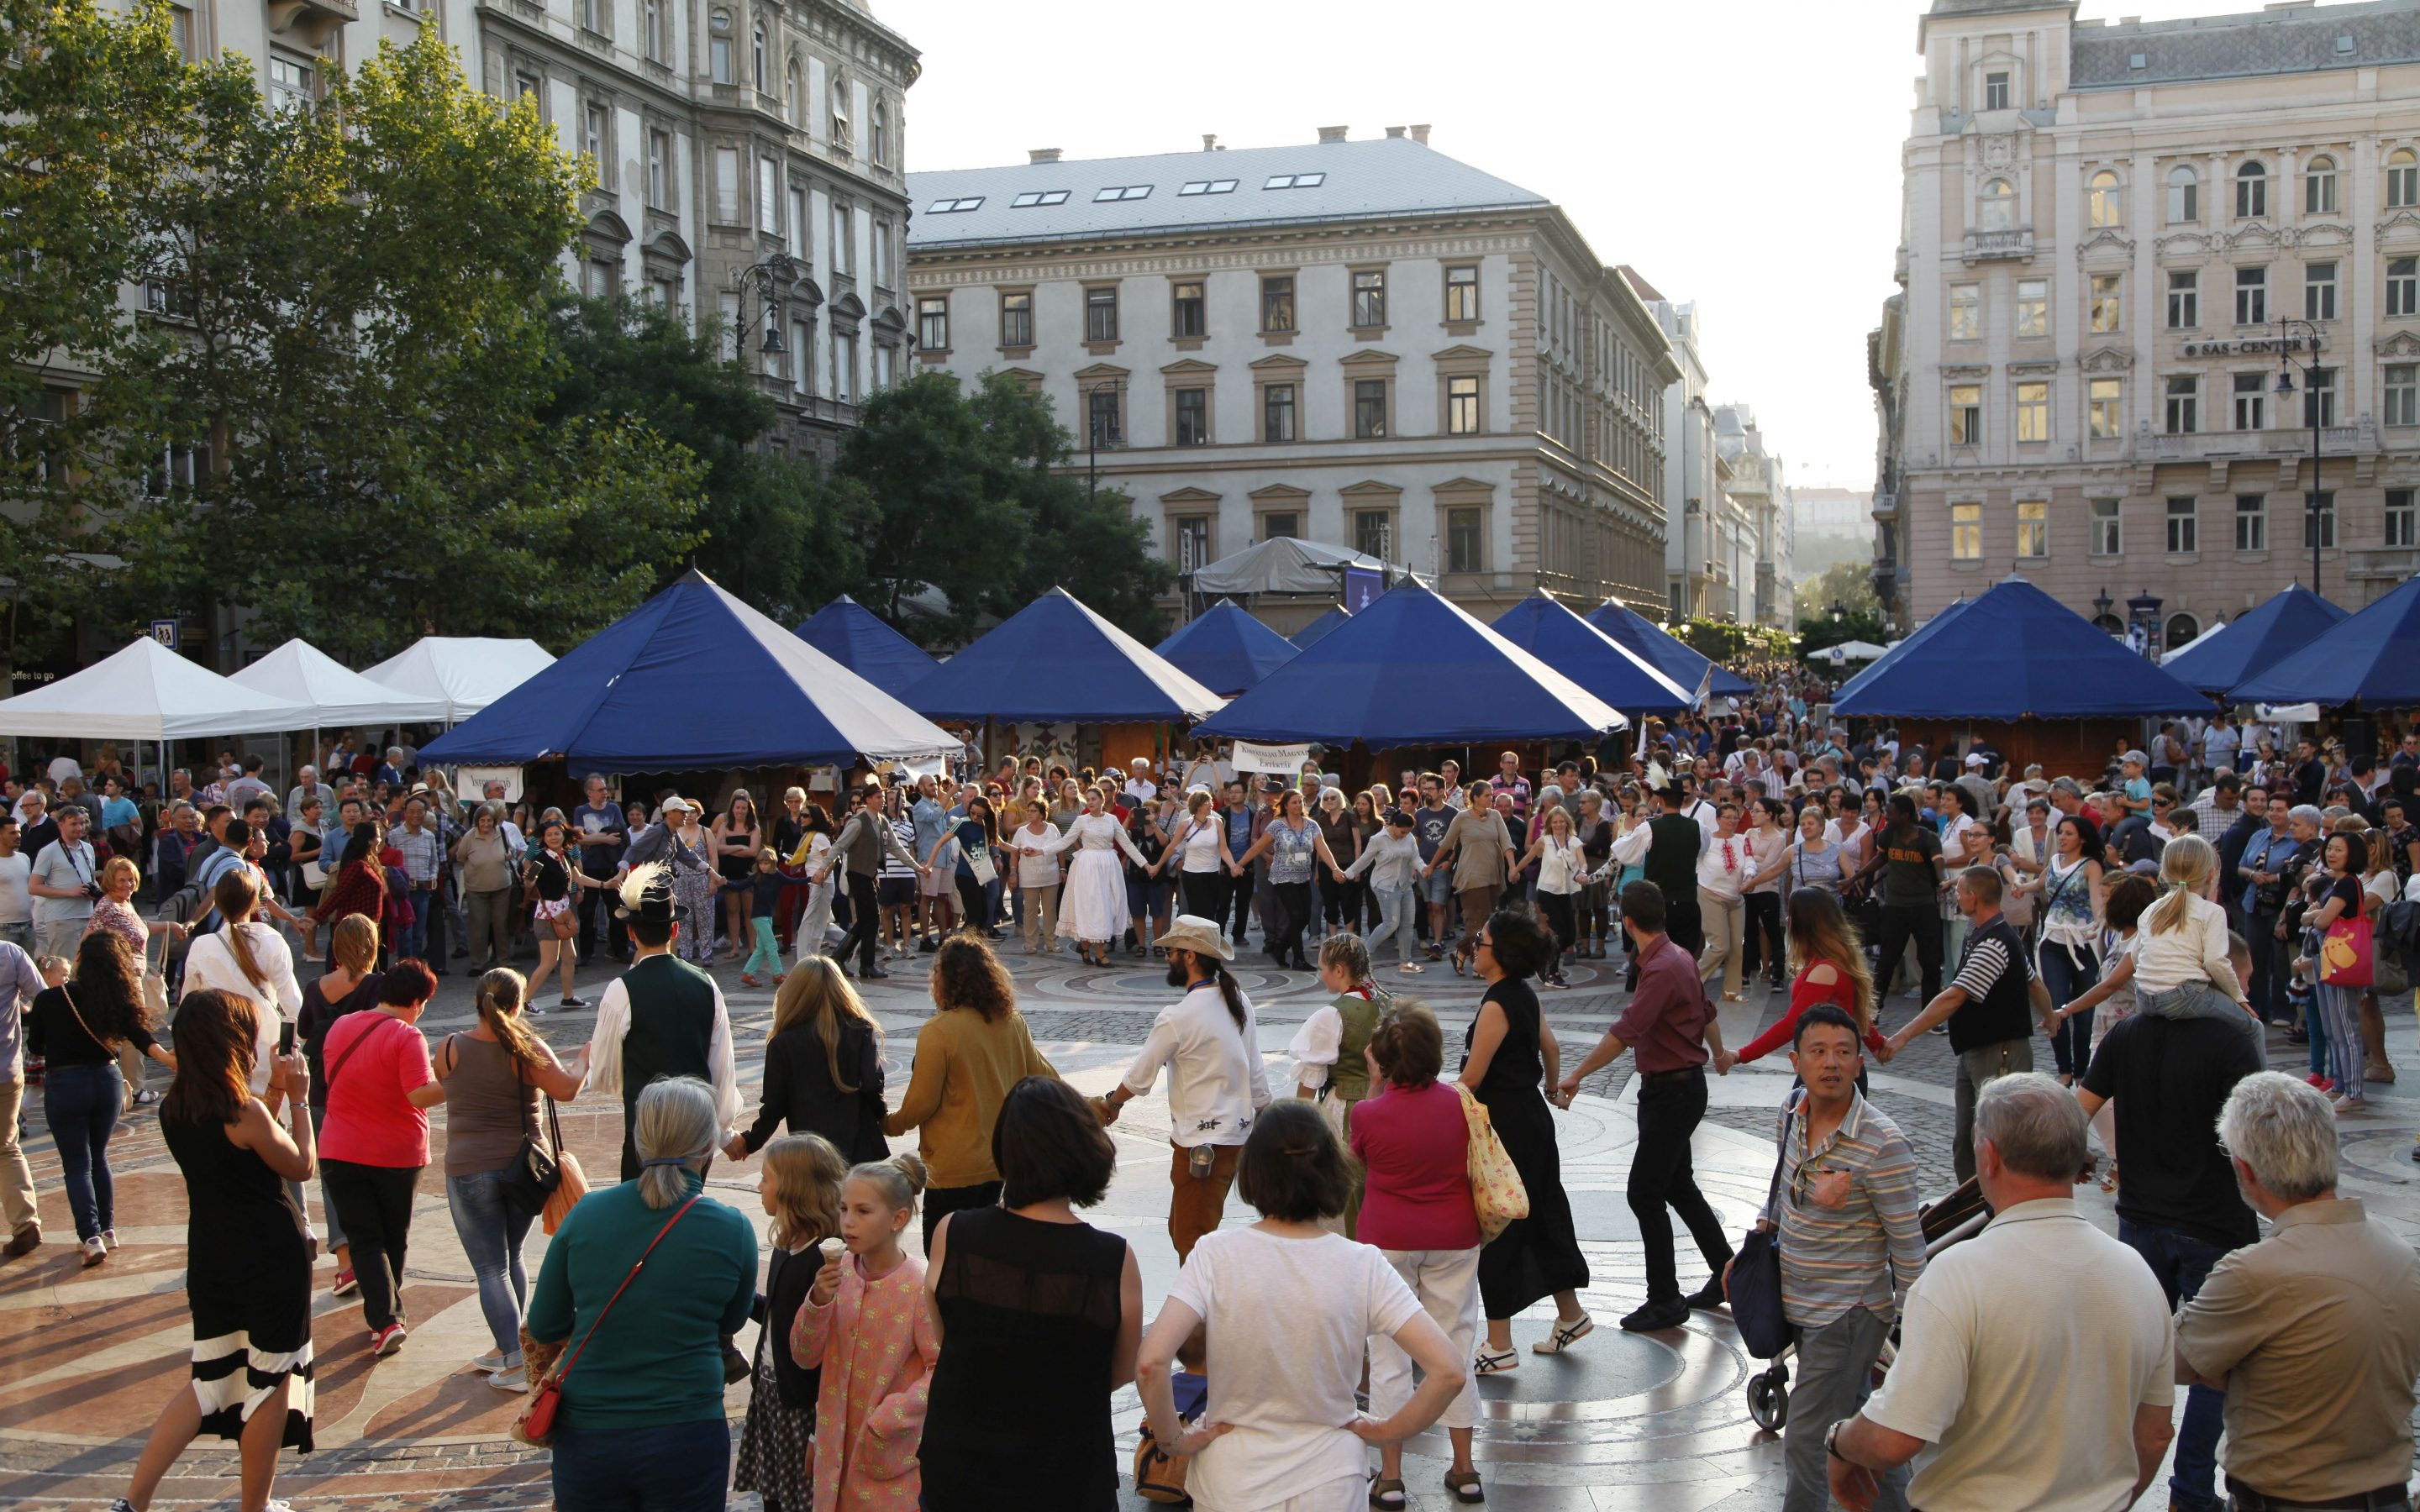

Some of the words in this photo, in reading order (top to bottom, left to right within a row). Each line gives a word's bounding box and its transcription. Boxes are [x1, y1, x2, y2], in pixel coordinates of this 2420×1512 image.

[34, 671, 42, 680] to
[44, 672, 55, 681] go
[1425, 819, 1444, 827] CONVERSE
